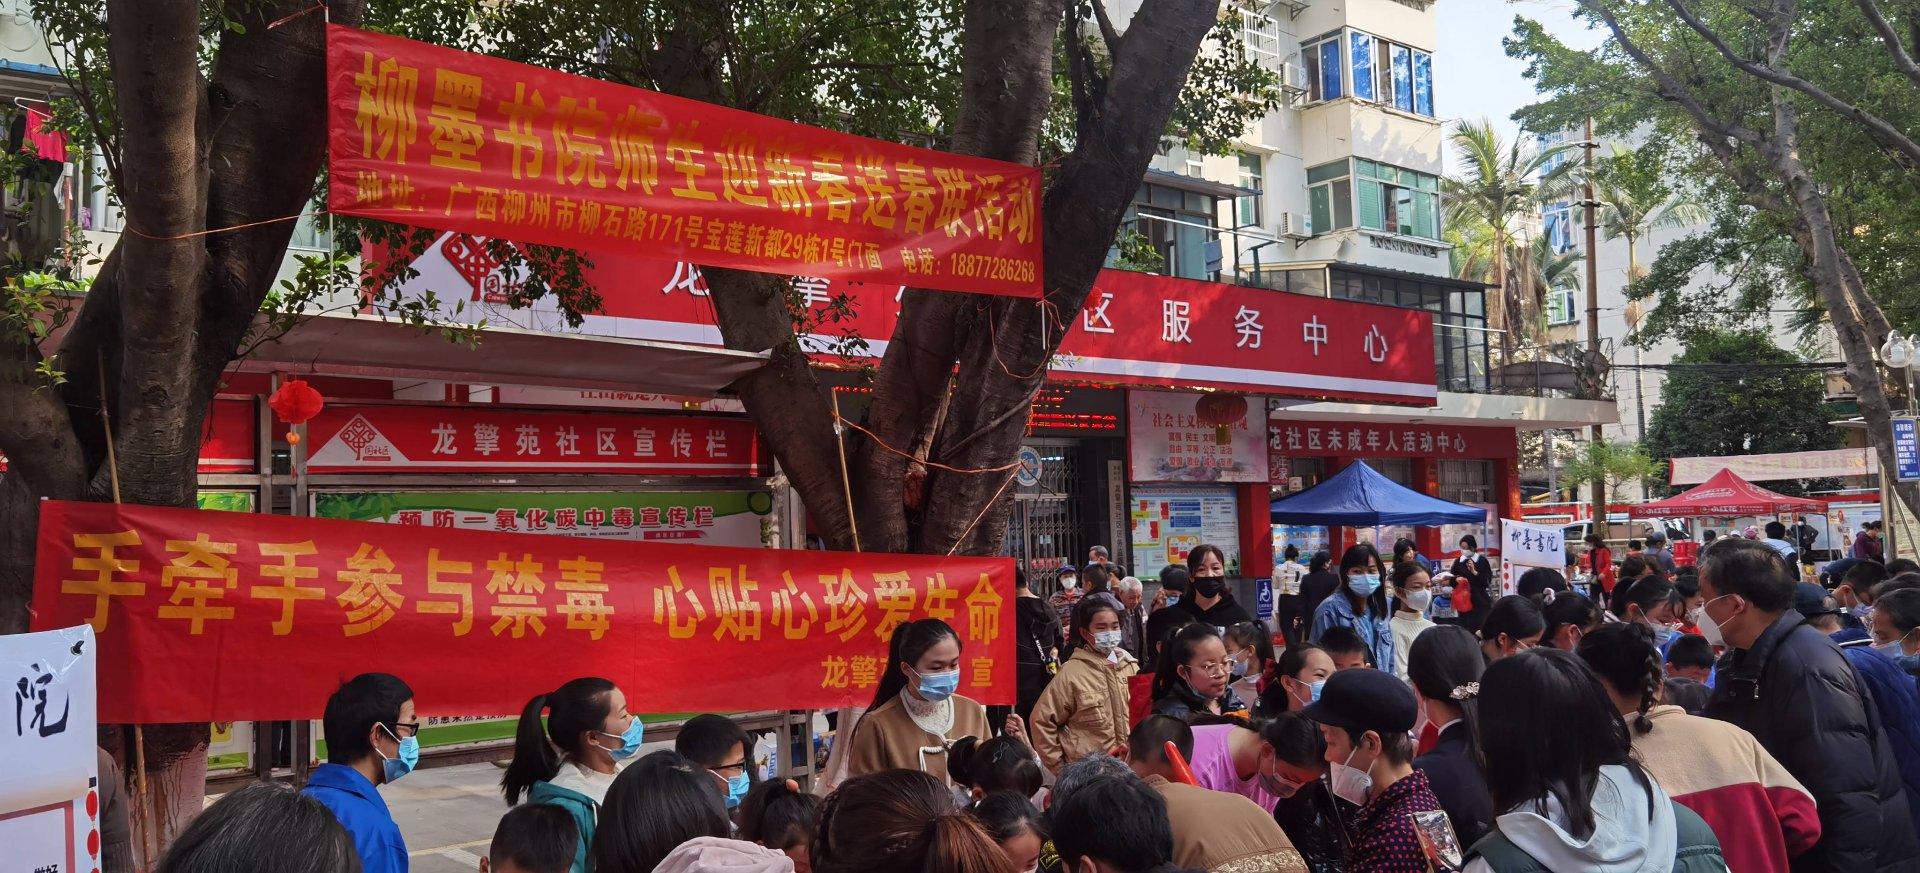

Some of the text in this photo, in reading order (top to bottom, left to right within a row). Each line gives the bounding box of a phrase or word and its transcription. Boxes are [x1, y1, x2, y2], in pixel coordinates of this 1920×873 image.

[355, 51, 1035, 245] 柳墨书院师生迎新春送春联活动
[431, 422, 728, 458] 龙擎苑社区宣传栏
[1169, 445, 1182, 453] 自由
[1202, 445, 1216, 454] 公正
[1185, 432, 1199, 442] 民主
[398, 506, 715, 530] 预防一氧化碳中毒宣传栏
[61, 529, 1003, 646] 手牵手参与禁毒 心贴心珍爱生命
[970, 656, 994, 687] 宣
[16, 663, 69, 738] 院
